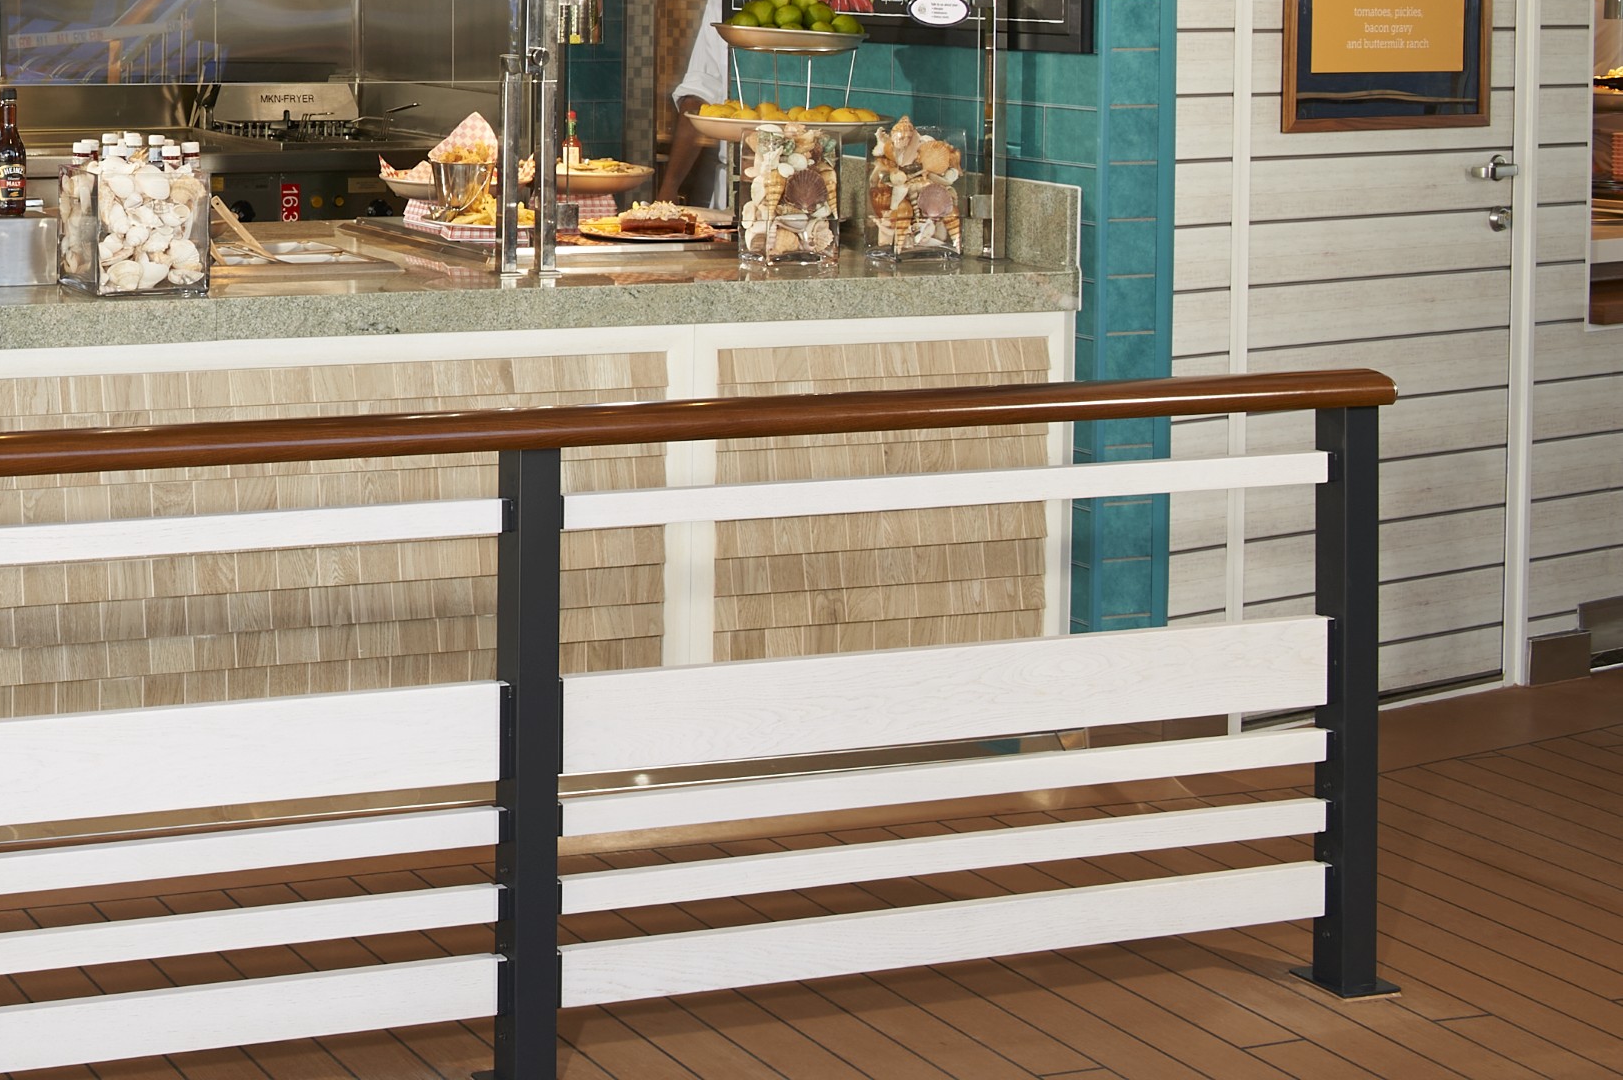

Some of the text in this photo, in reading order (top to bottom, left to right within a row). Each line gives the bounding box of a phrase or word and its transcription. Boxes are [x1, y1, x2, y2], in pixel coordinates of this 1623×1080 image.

[1354, 6, 1423, 19] tomatoes, pickles,
[1364, 22, 1413, 35] bacon gravy
[1347, 38, 1429, 49] and buttermilk ranch
[260, 94, 315, 104] MKN-FRYER
[3, 166, 24, 175] HEINZ
